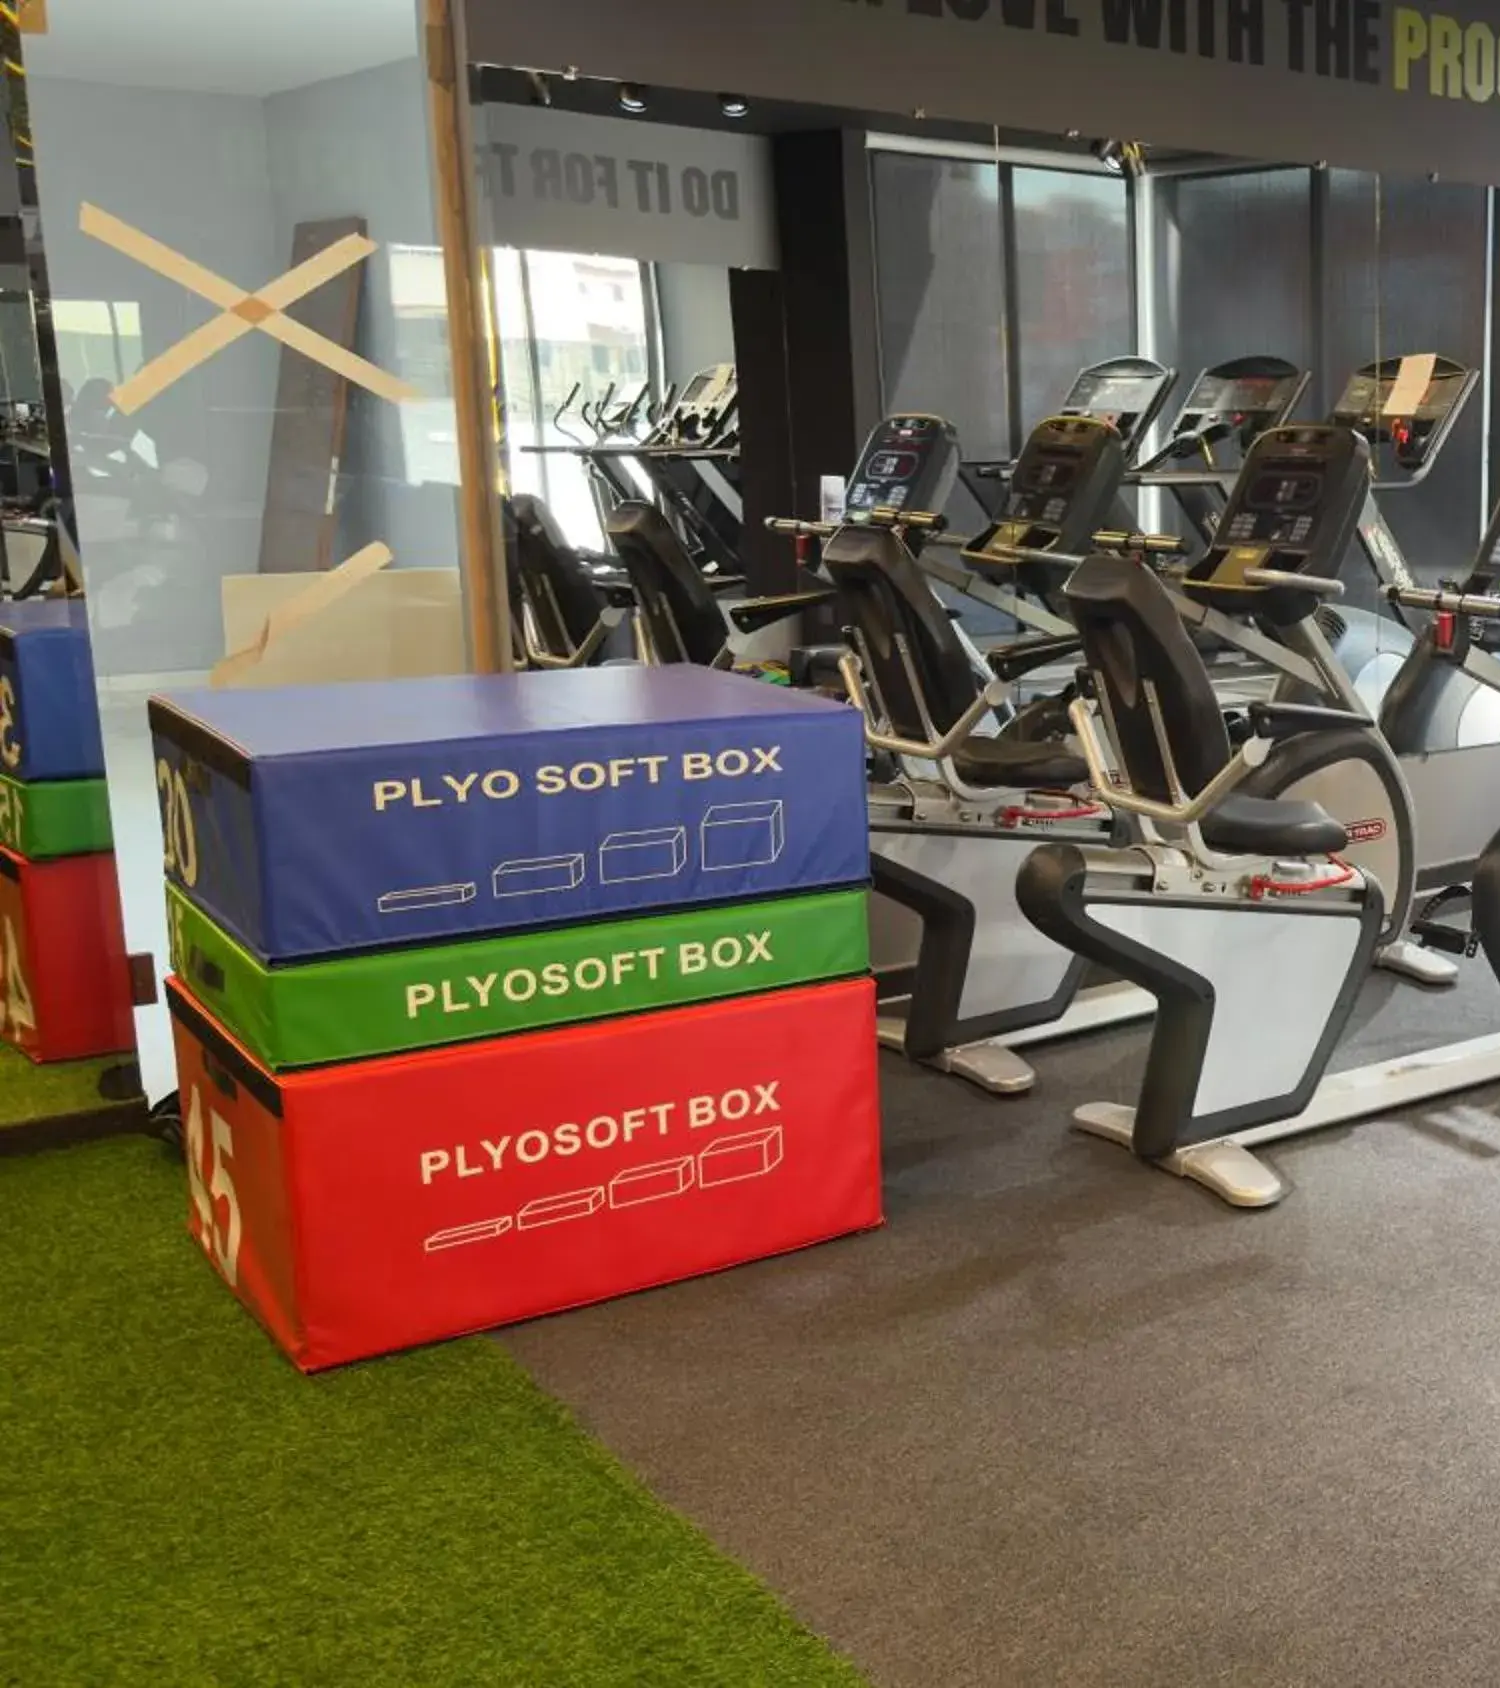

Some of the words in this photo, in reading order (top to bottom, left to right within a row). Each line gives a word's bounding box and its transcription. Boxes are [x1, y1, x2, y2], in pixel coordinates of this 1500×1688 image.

[1102, 0, 1265, 66] WITH
[1286, 0, 1380, 86] THE
[373, 770, 520, 811] PLYO
[536, 755, 668, 794] SOFT
[682, 745, 783, 780] BOX
[406, 947, 665, 1018] PLYOSOFT
[679, 931, 773, 975] BOX
[421, 1102, 675, 1185] PLYOSOFT
[688, 1081, 780, 1129] BOX
